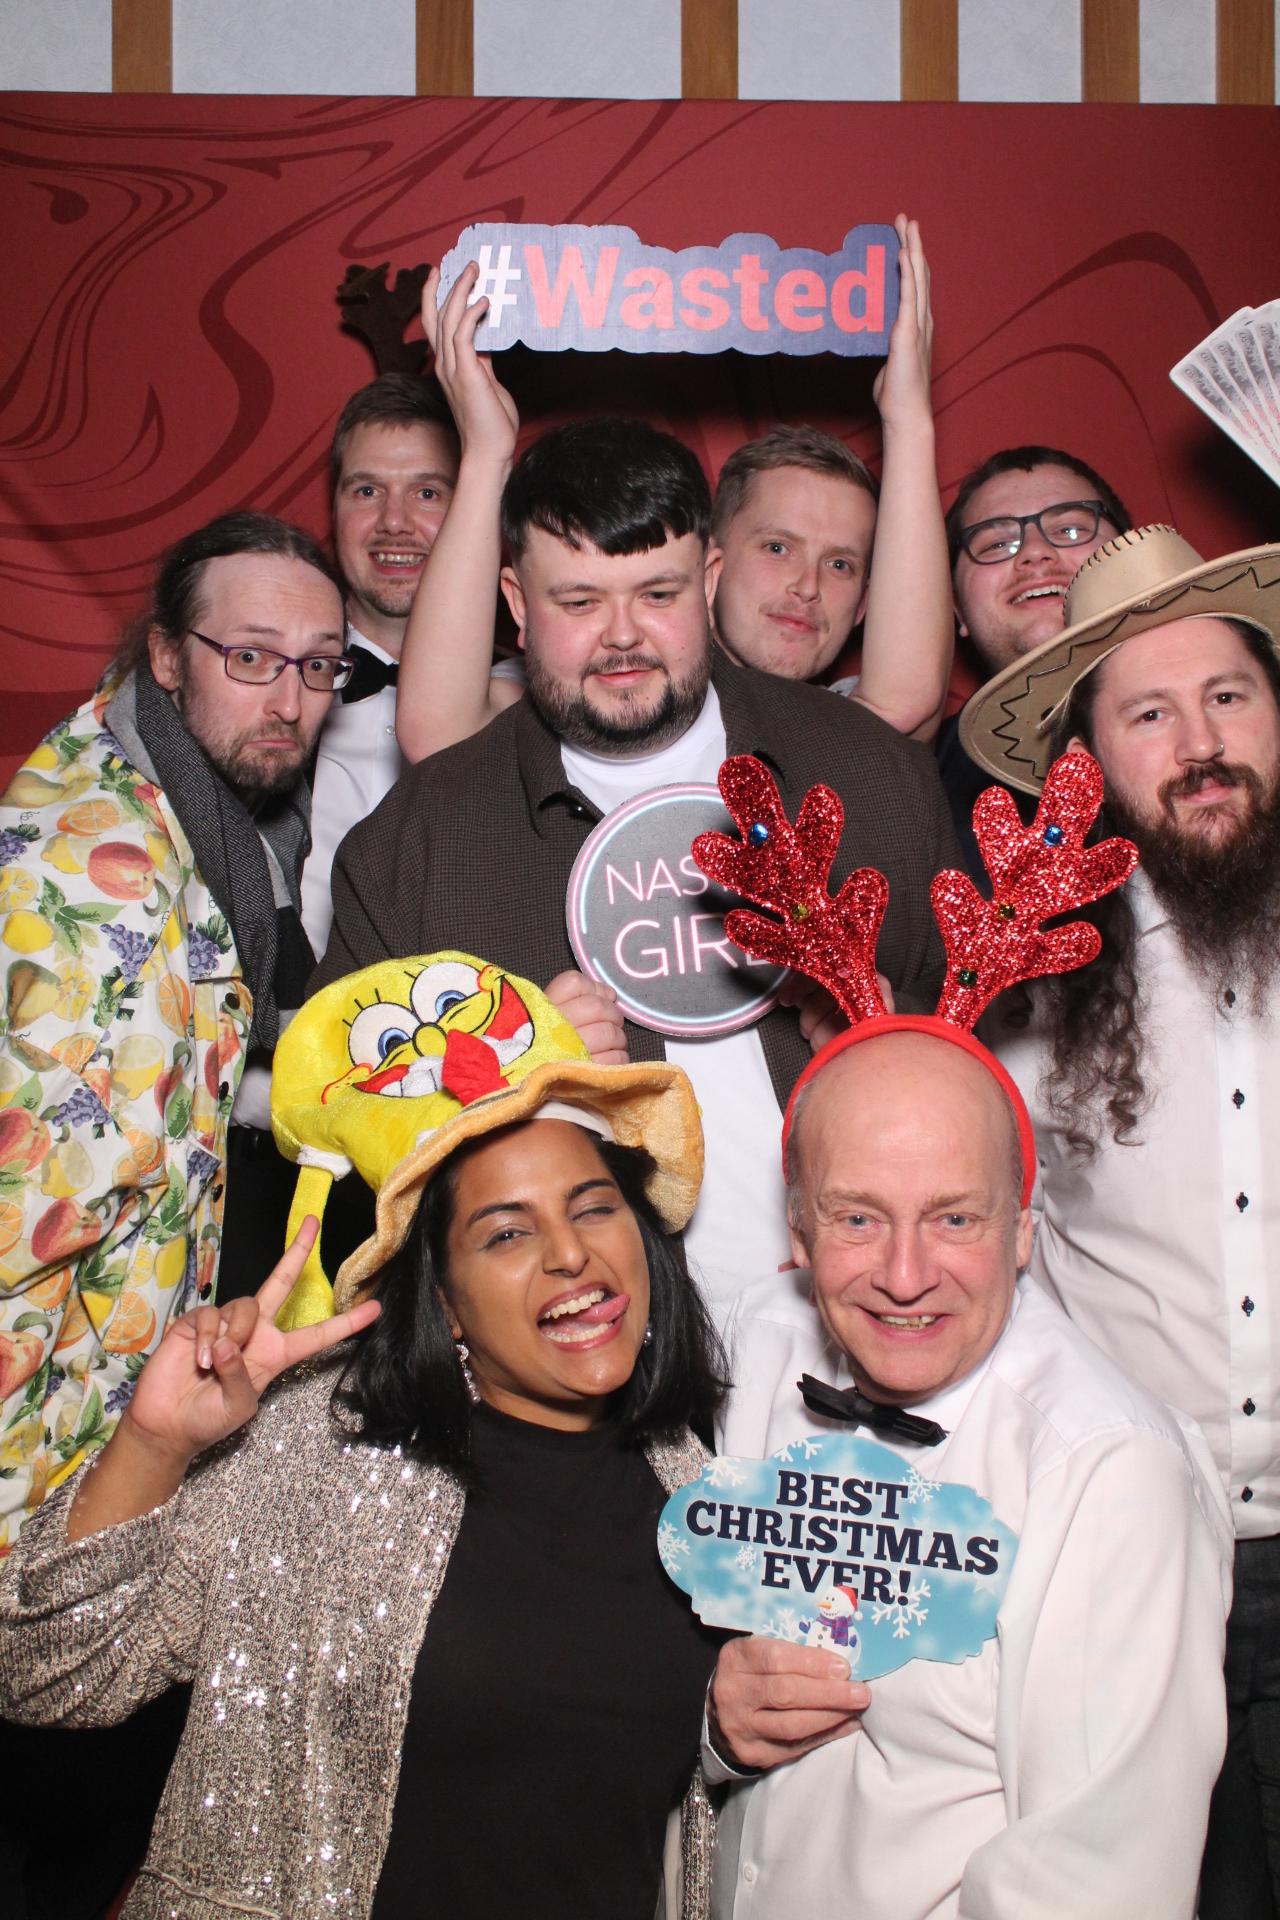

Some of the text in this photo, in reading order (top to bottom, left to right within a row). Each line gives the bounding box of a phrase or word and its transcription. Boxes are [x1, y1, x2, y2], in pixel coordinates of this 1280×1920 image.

[468, 244, 886, 332] #Wasted
[605, 855, 729, 905] NAS
[776, 1469, 909, 1520] BEST
[686, 1500, 999, 1576] CHRISTMAS
[761, 1551, 911, 1606] EVER!
